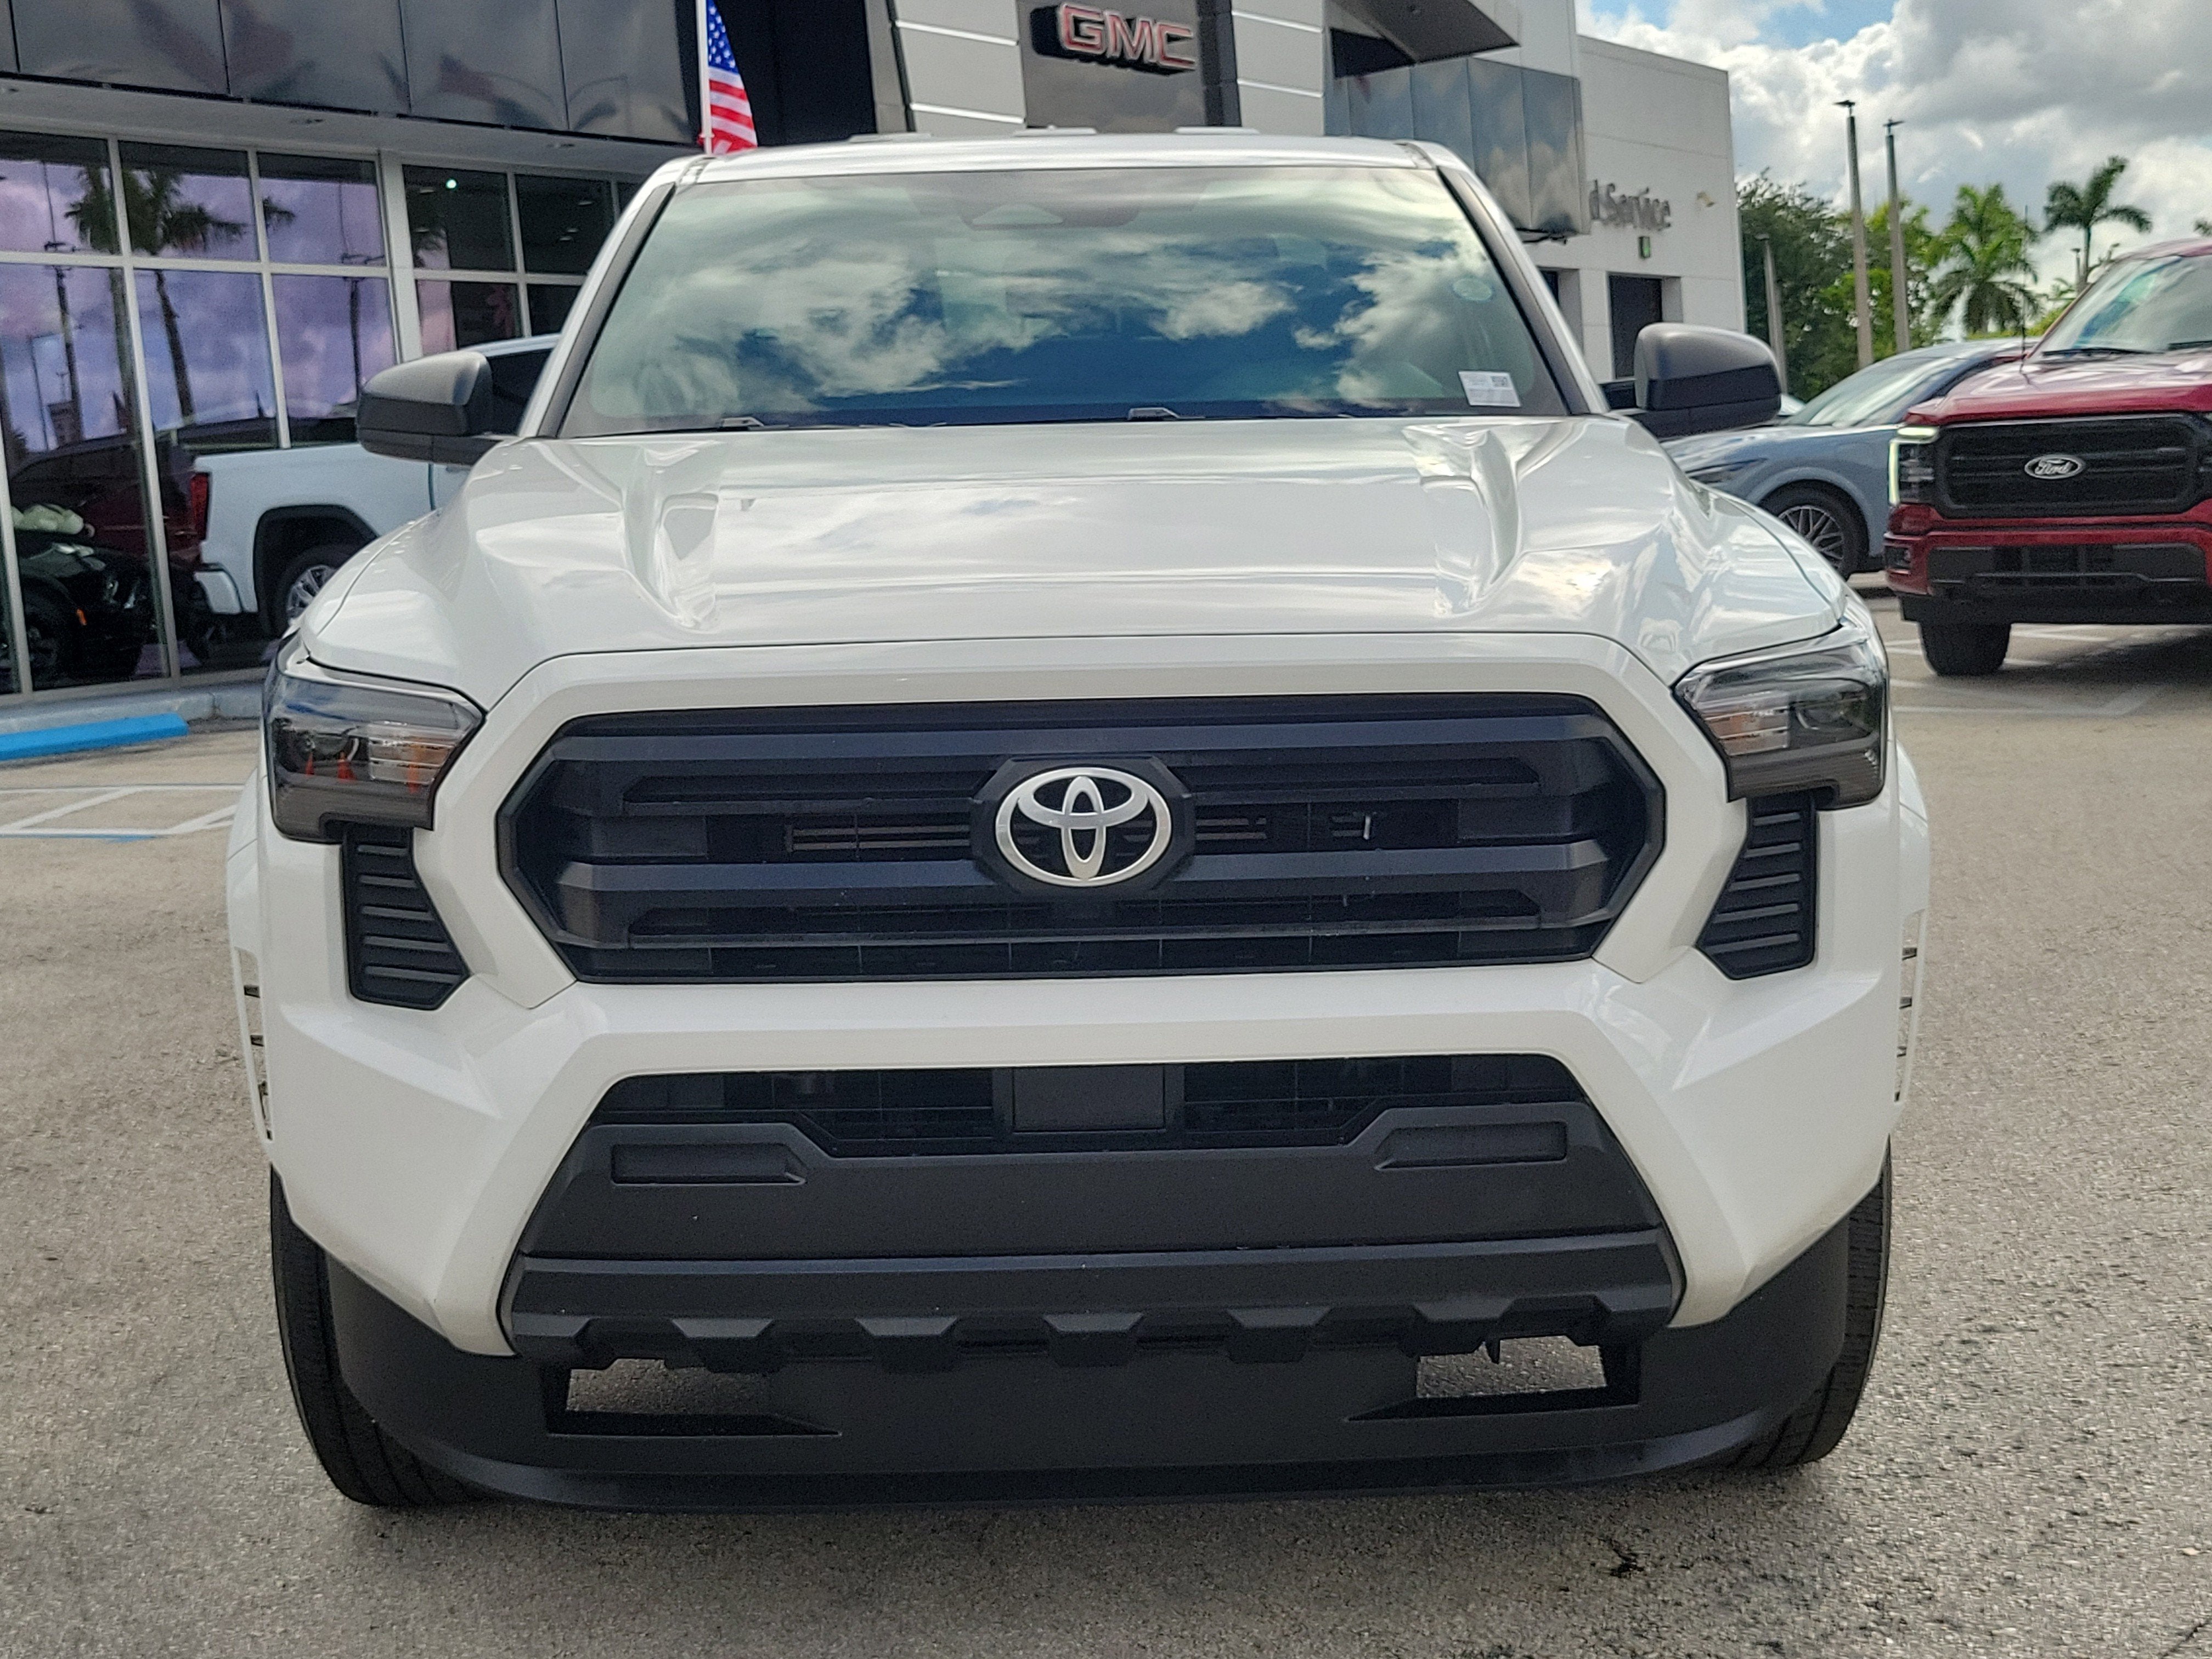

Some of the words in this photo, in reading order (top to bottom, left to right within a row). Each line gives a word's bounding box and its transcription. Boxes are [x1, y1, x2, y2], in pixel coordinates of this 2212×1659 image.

[1058, 4, 1195, 69] GMC
[1602, 183, 1671, 232] Service
[2033, 458, 2074, 476] Ford
